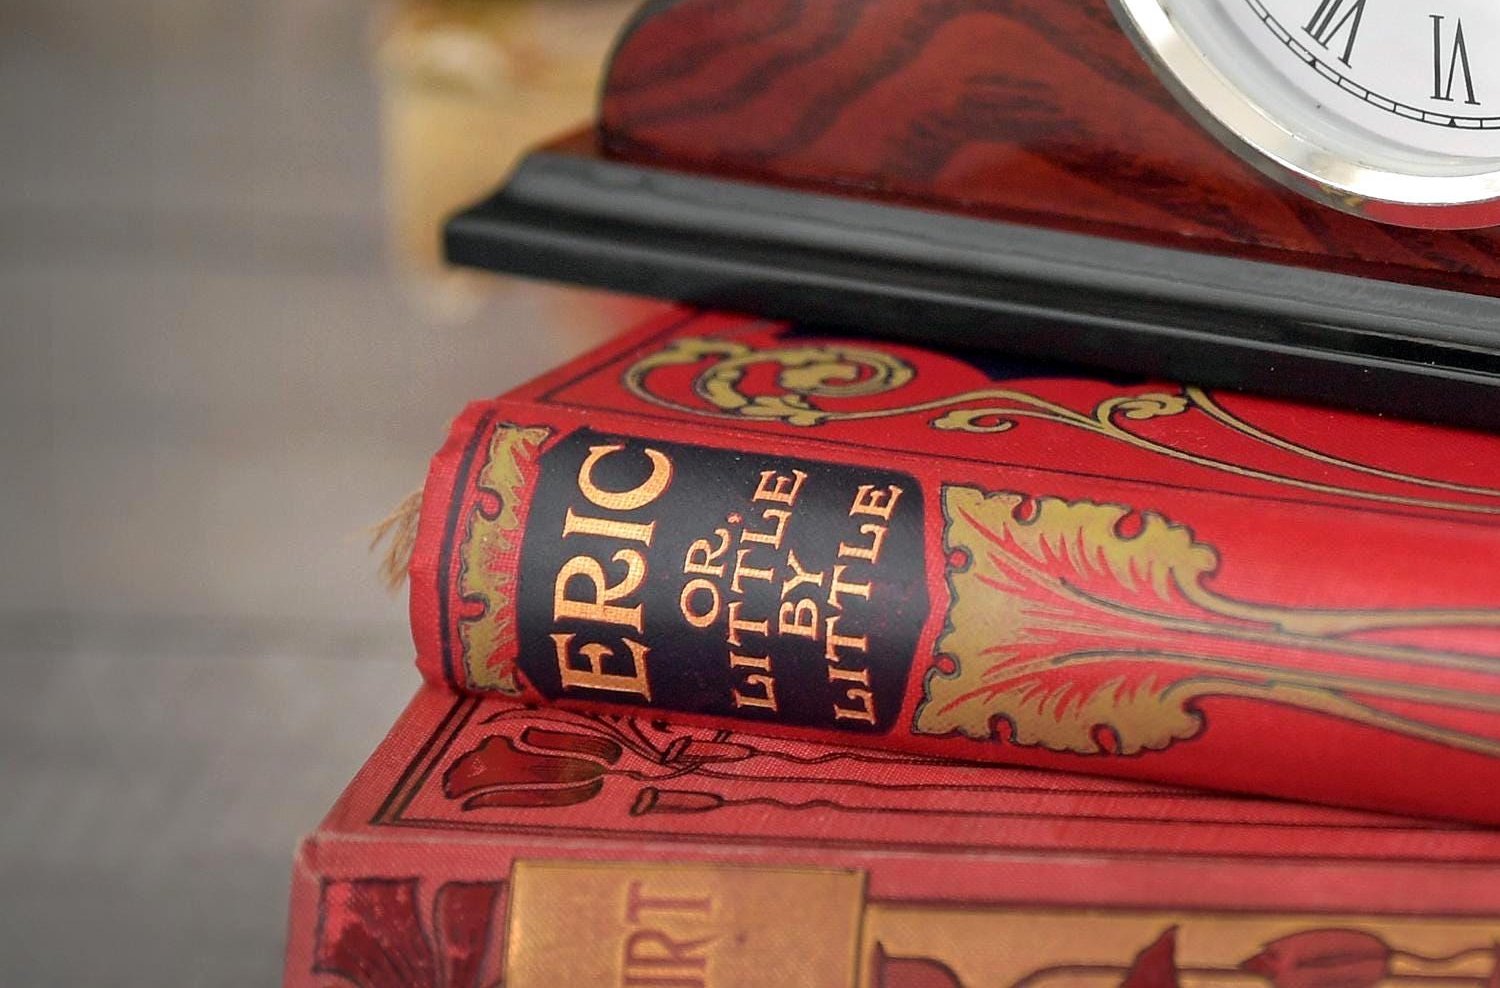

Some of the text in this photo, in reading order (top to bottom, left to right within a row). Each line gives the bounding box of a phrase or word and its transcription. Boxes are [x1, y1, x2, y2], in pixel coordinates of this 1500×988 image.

[1429, 14, 1481, 105] VI
[548, 444, 674, 703] ERIC
[726, 468, 808, 712] LITTLE
[778, 549, 825, 641] BY
[824, 483, 903, 726] LITTLE
